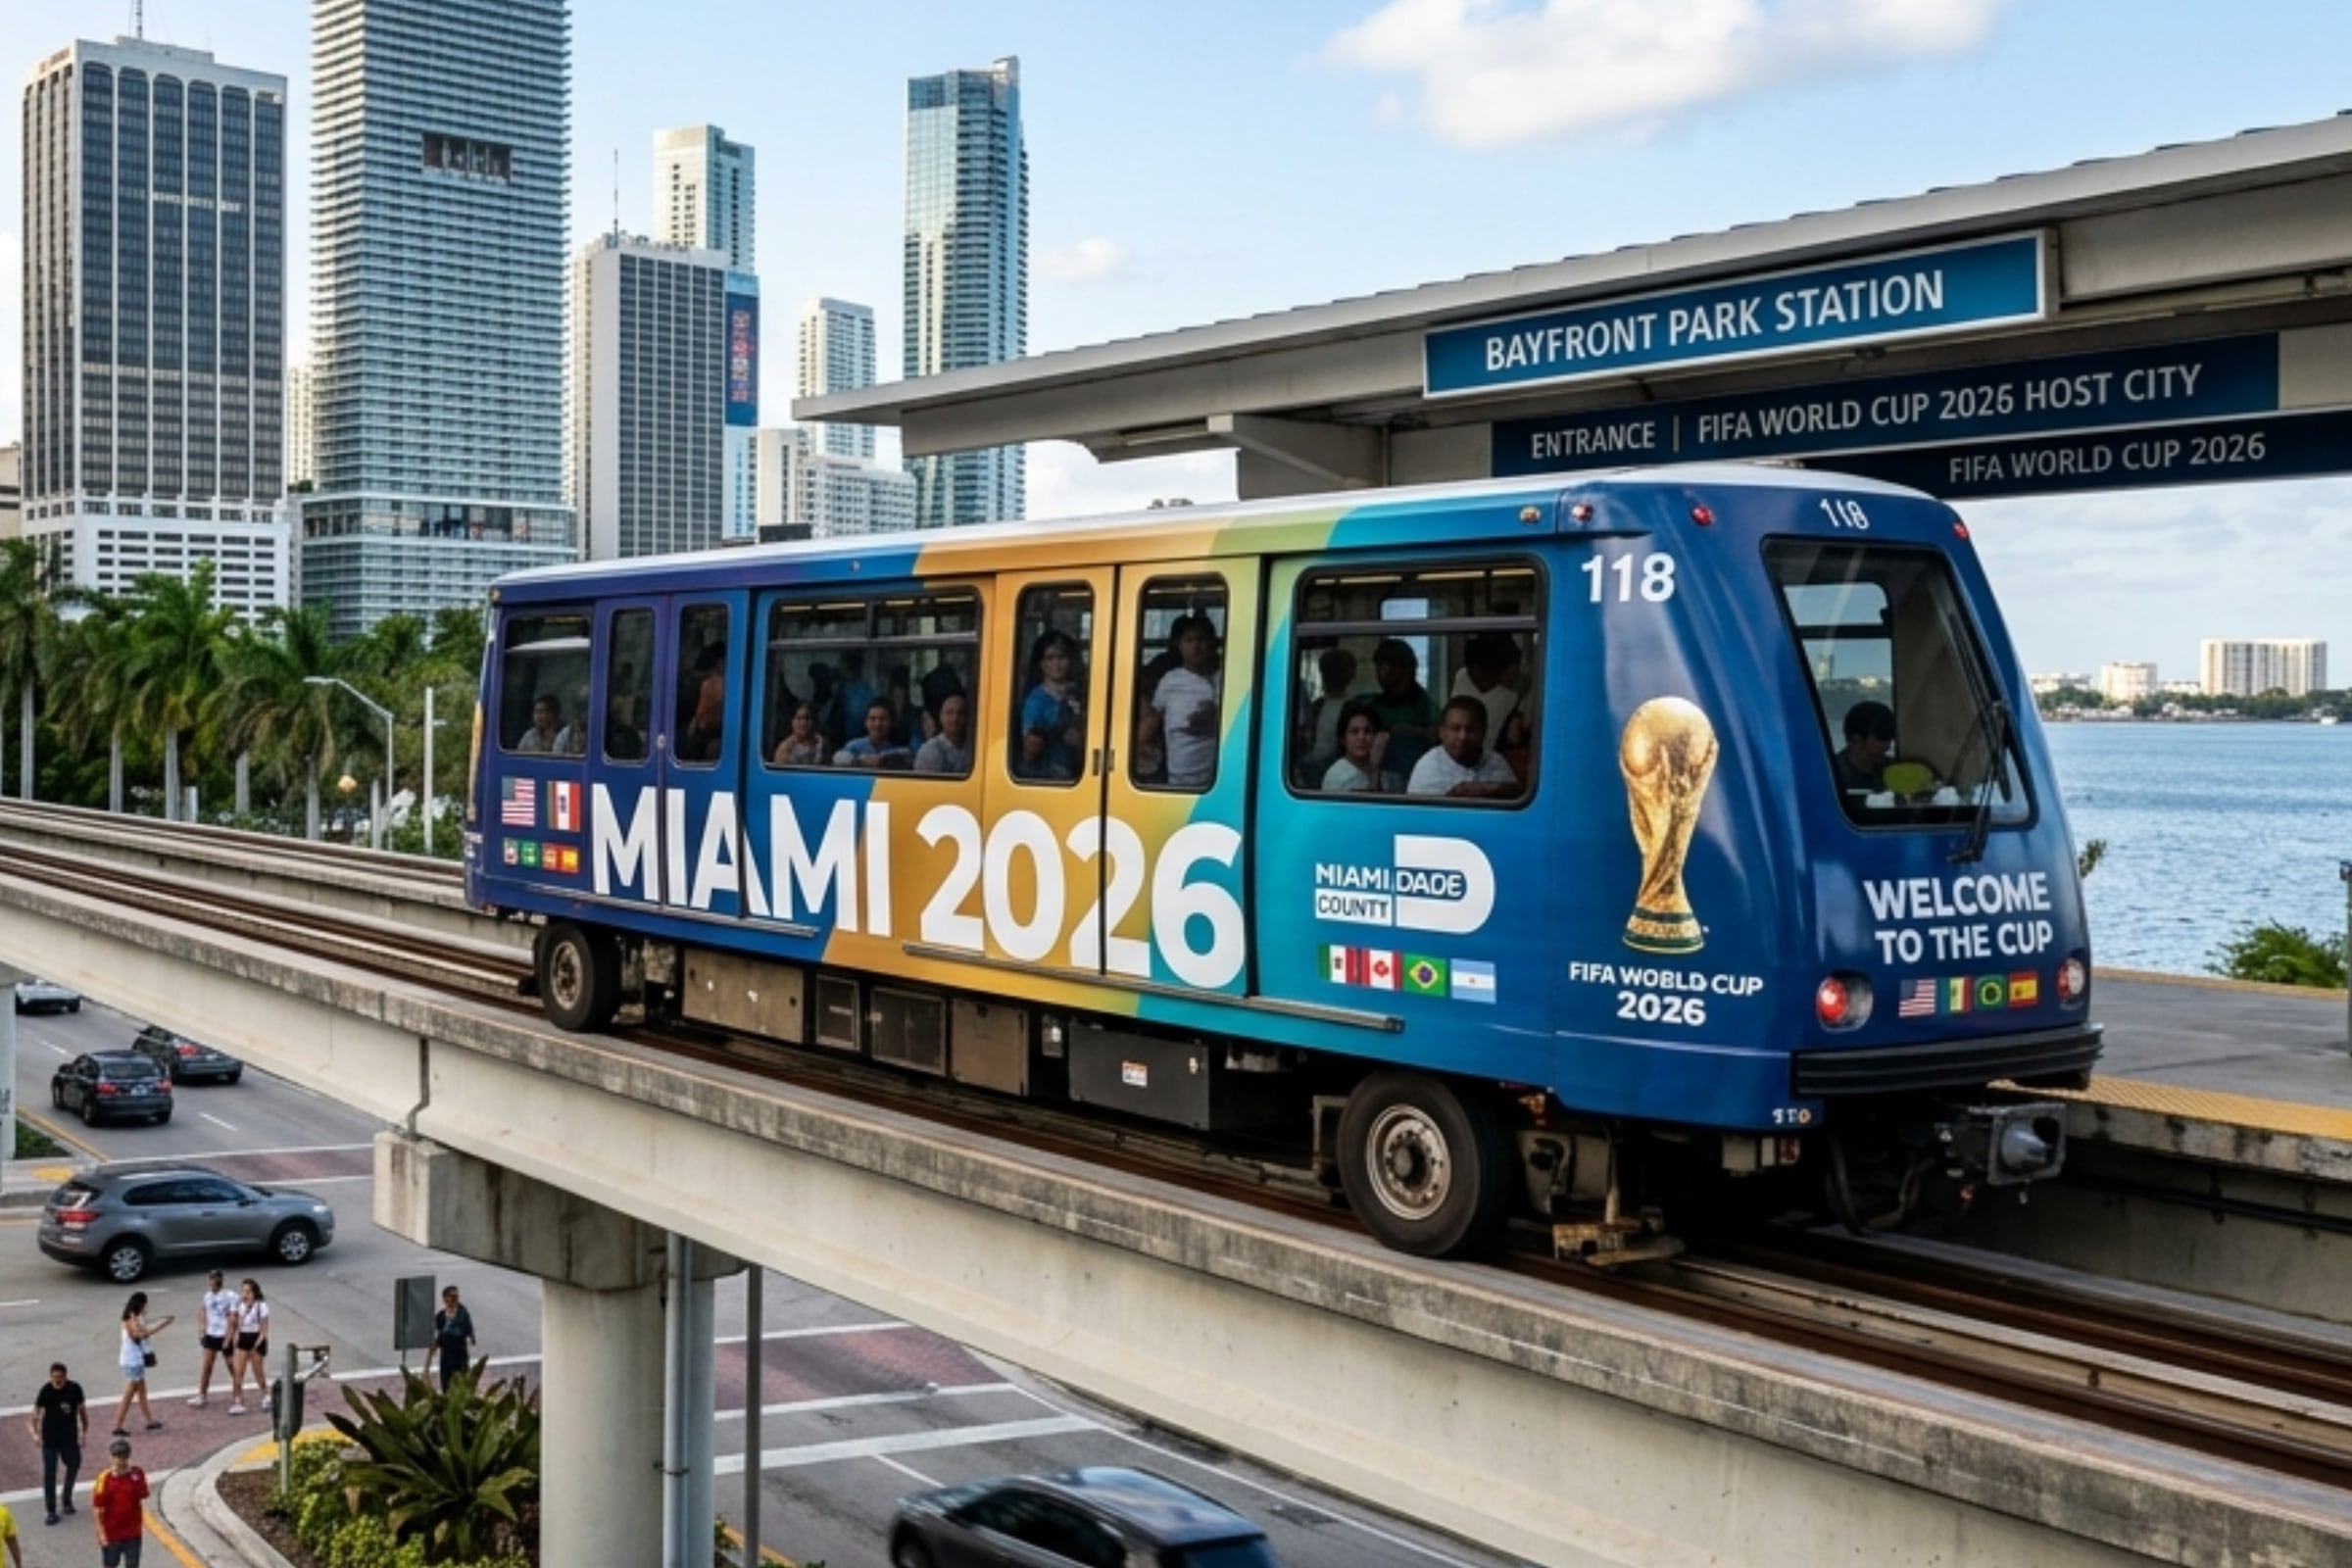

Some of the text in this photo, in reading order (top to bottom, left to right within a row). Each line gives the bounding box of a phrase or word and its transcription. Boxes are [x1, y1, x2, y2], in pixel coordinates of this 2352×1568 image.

[1486, 270, 1944, 371] BAYFRONT PARK STATION
[1531, 364, 2202, 460] ENTRANCE FIFA WORLD CUP 2026 HOST CITY
[1949, 433, 2267, 484] FIFA WORLD CUP 2026
[1820, 497, 1871, 530] 118
[1582, 553, 1676, 603] 118
[590, 783, 1245, 989] MIAMI 2026
[1315, 862, 1463, 898] MIAMI DADE
[1864, 871, 2052, 921] WELCOME
[1875, 919, 2053, 964] TO THE CUP
[1569, 961, 1616, 985] FIFA
[1710, 974, 1765, 997] CUP
[1616, 991, 1707, 1027] 2026
